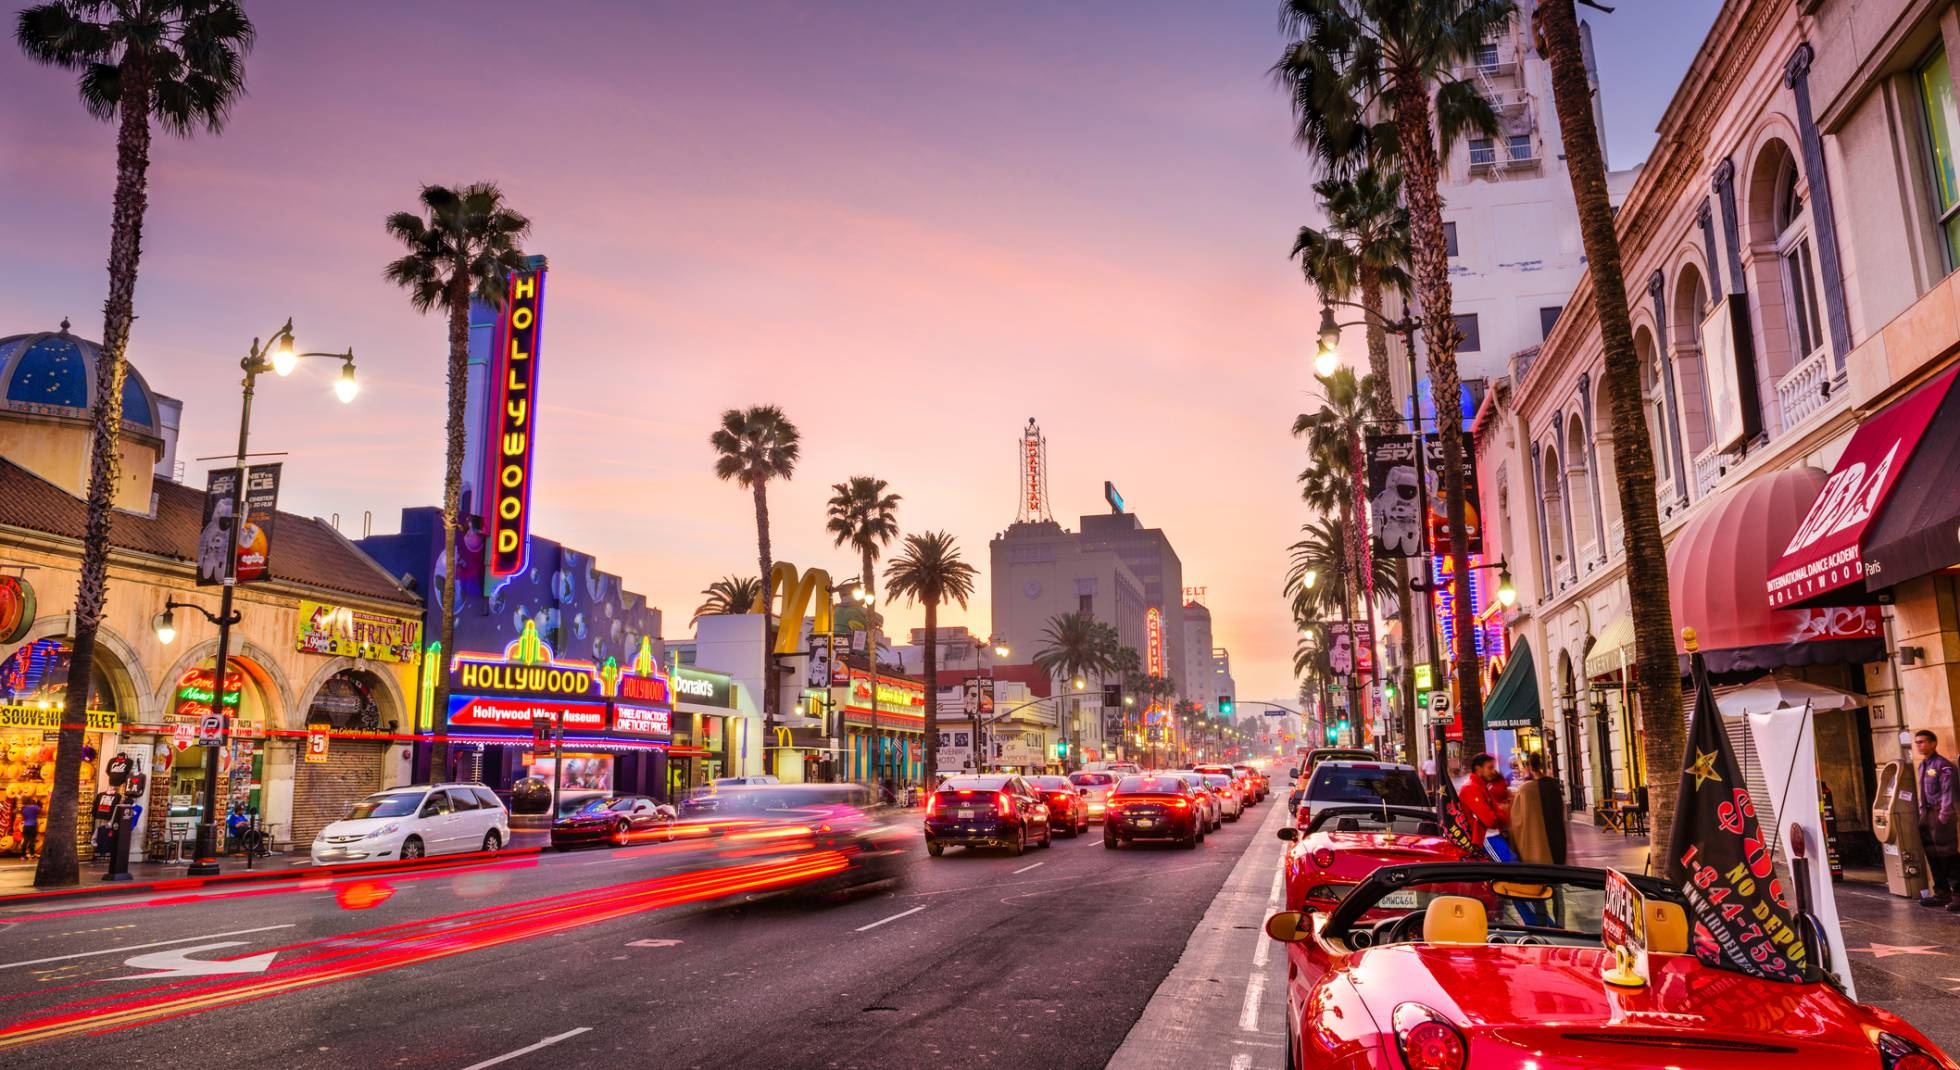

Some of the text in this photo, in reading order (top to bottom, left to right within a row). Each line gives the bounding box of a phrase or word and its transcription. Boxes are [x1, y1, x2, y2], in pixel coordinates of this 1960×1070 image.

[498, 276, 534, 553] HOLLYWOOD
[1767, 544, 1859, 592] INTERNATIONAL DANCE ACADEMY
[1864, 560, 1882, 577] Paris
[1768, 561, 1863, 606] HOLLYWOOD
[462, 663, 590, 694] HOLLYWOOD
[676, 675, 713, 697] Donald's
[623, 677, 665, 701] HOLLYWOOD
[2, 707, 61, 726] SOUVENI
[473, 704, 531, 720] Hollywood
[533, 708, 557, 720] Wax
[618, 707, 668, 721] THREE ATTRACTIONS
[175, 725, 193, 736] ATM
[617, 718, 632, 729] ONE
[632, 719, 651, 731] TICKET
[309, 734, 324, 753] $5
[1725, 862, 1756, 896] NO
